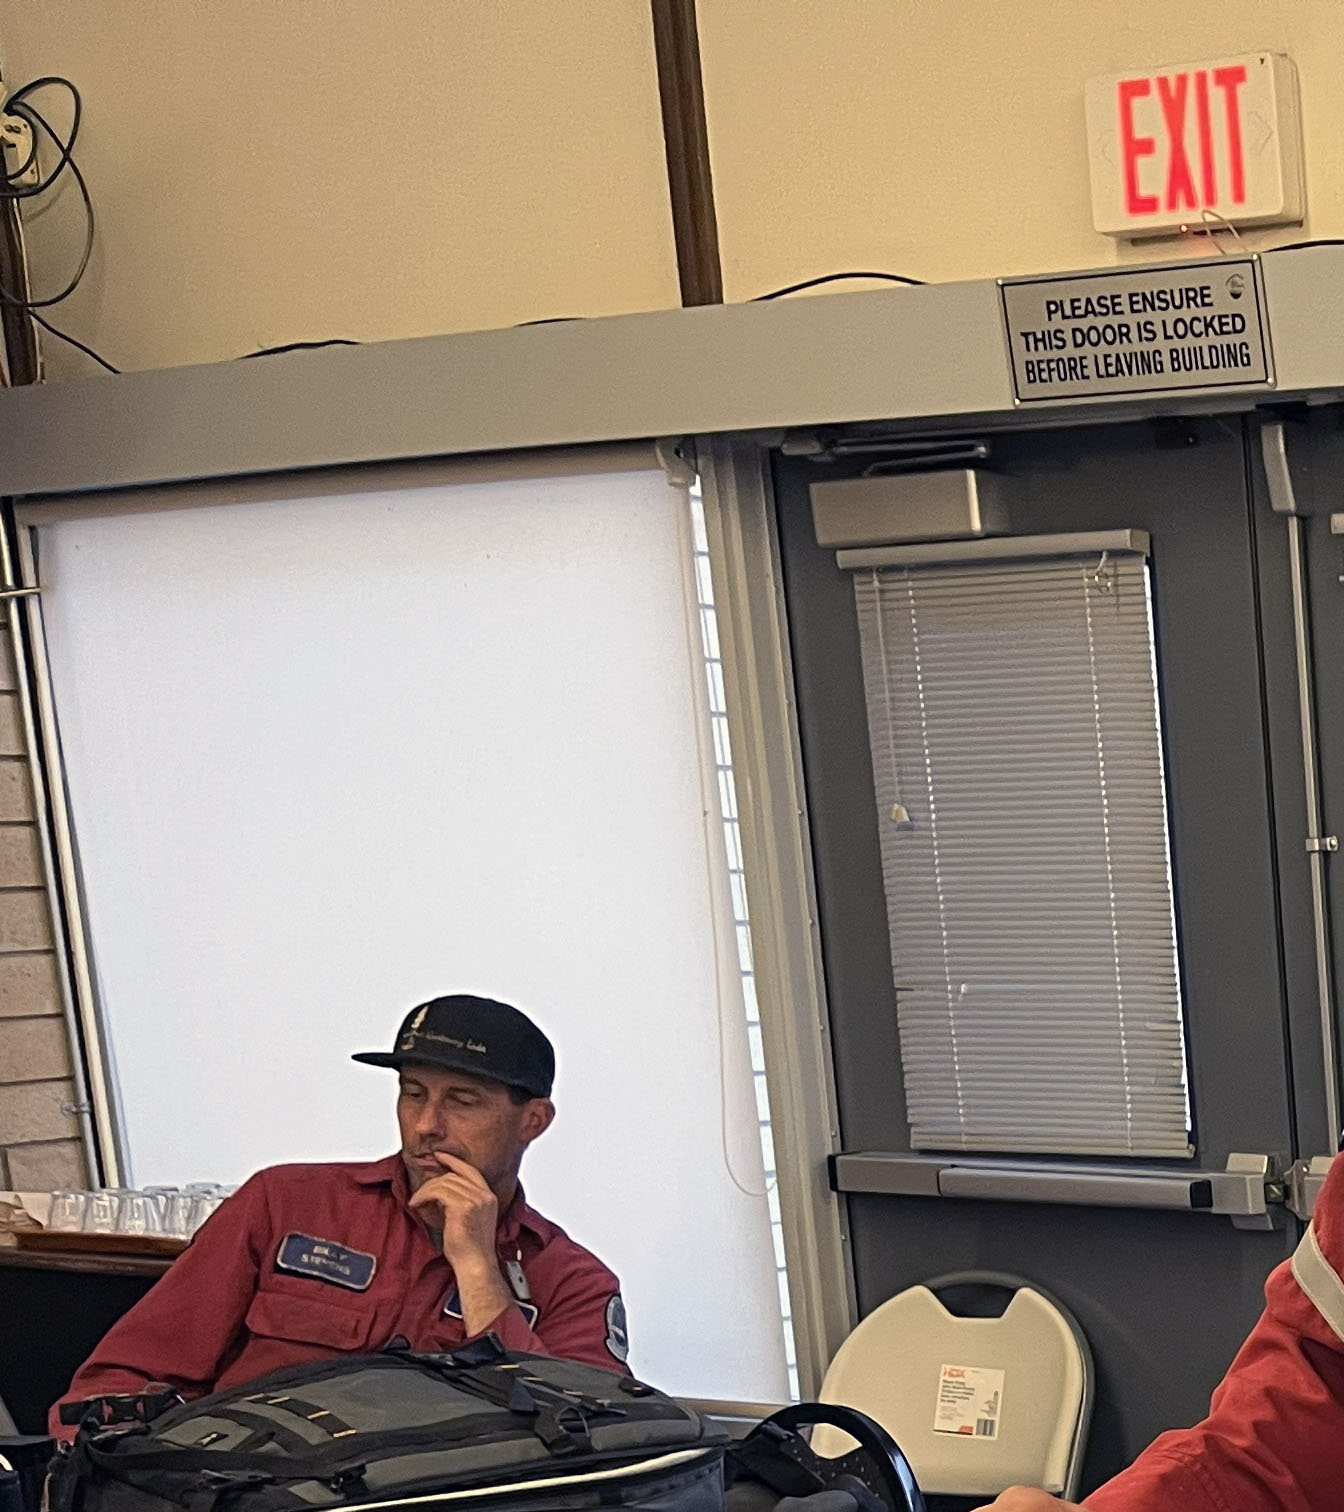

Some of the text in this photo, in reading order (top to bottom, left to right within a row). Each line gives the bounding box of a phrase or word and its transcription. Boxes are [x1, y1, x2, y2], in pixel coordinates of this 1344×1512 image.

[1117, 65, 1247, 216] EXIT
[1046, 285, 1214, 322] PLEASE ENSURE
[1020, 313, 1246, 352] THIS DOOR IS LOCKED
[1025, 341, 1252, 384] BEFORE LEAVING BUILDING
